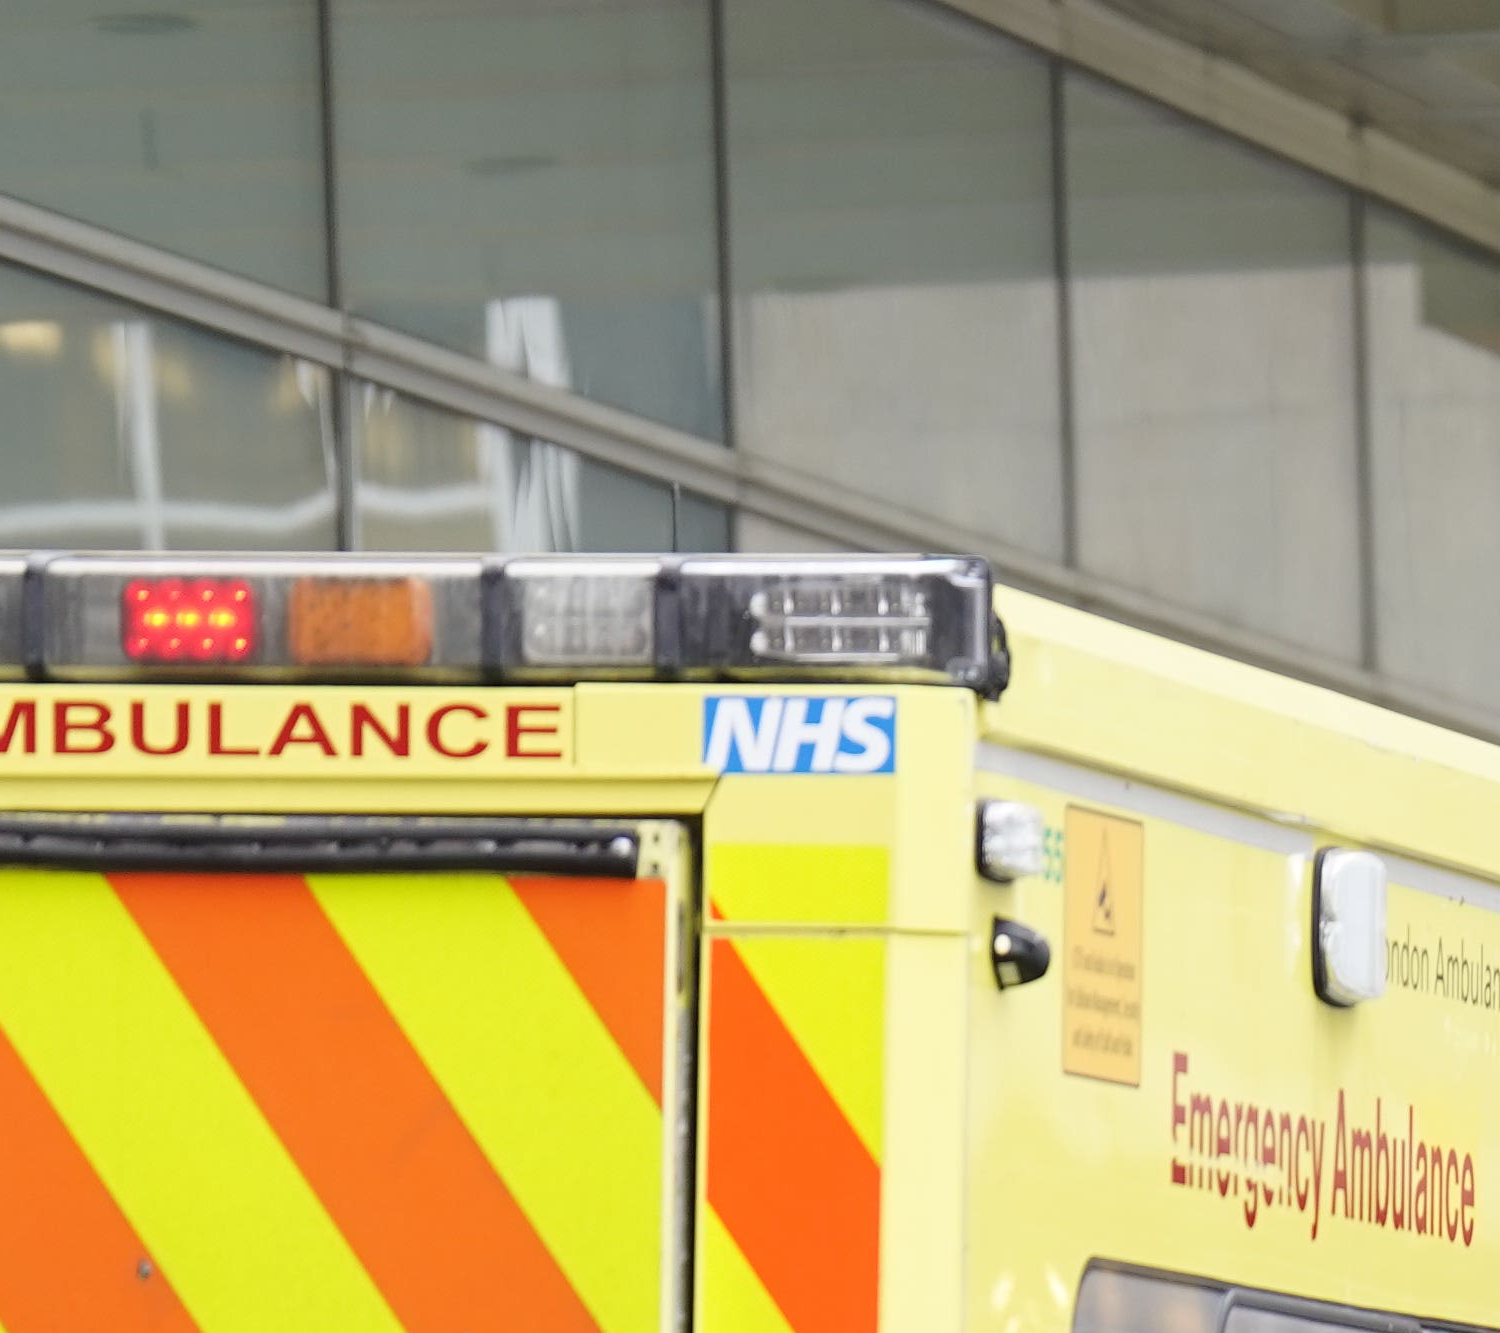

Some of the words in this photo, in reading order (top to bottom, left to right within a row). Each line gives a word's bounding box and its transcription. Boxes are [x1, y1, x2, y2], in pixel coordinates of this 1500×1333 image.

[706, 698, 895, 774] NHS
[1170, 1052, 1326, 1241] Emergency
[1330, 1088, 1476, 1248] Ambulance
